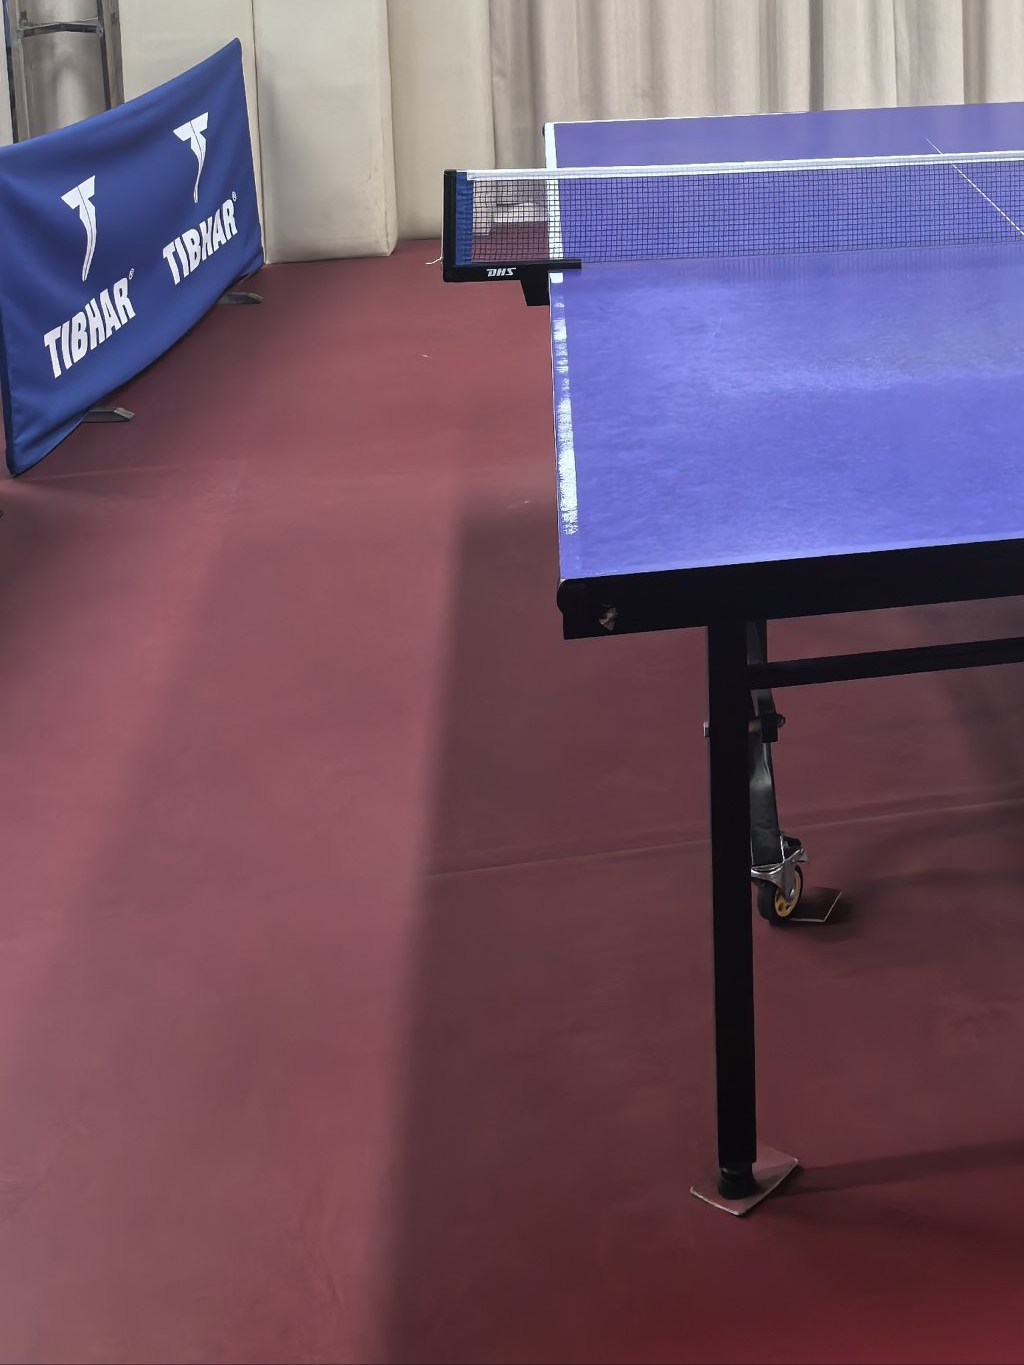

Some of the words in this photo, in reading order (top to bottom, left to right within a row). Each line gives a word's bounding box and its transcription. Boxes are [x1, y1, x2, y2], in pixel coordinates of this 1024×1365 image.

[162, 197, 238, 286] TIBHAR
[486, 267, 517, 277] DHS
[43, 276, 136, 379] TIBHAR
